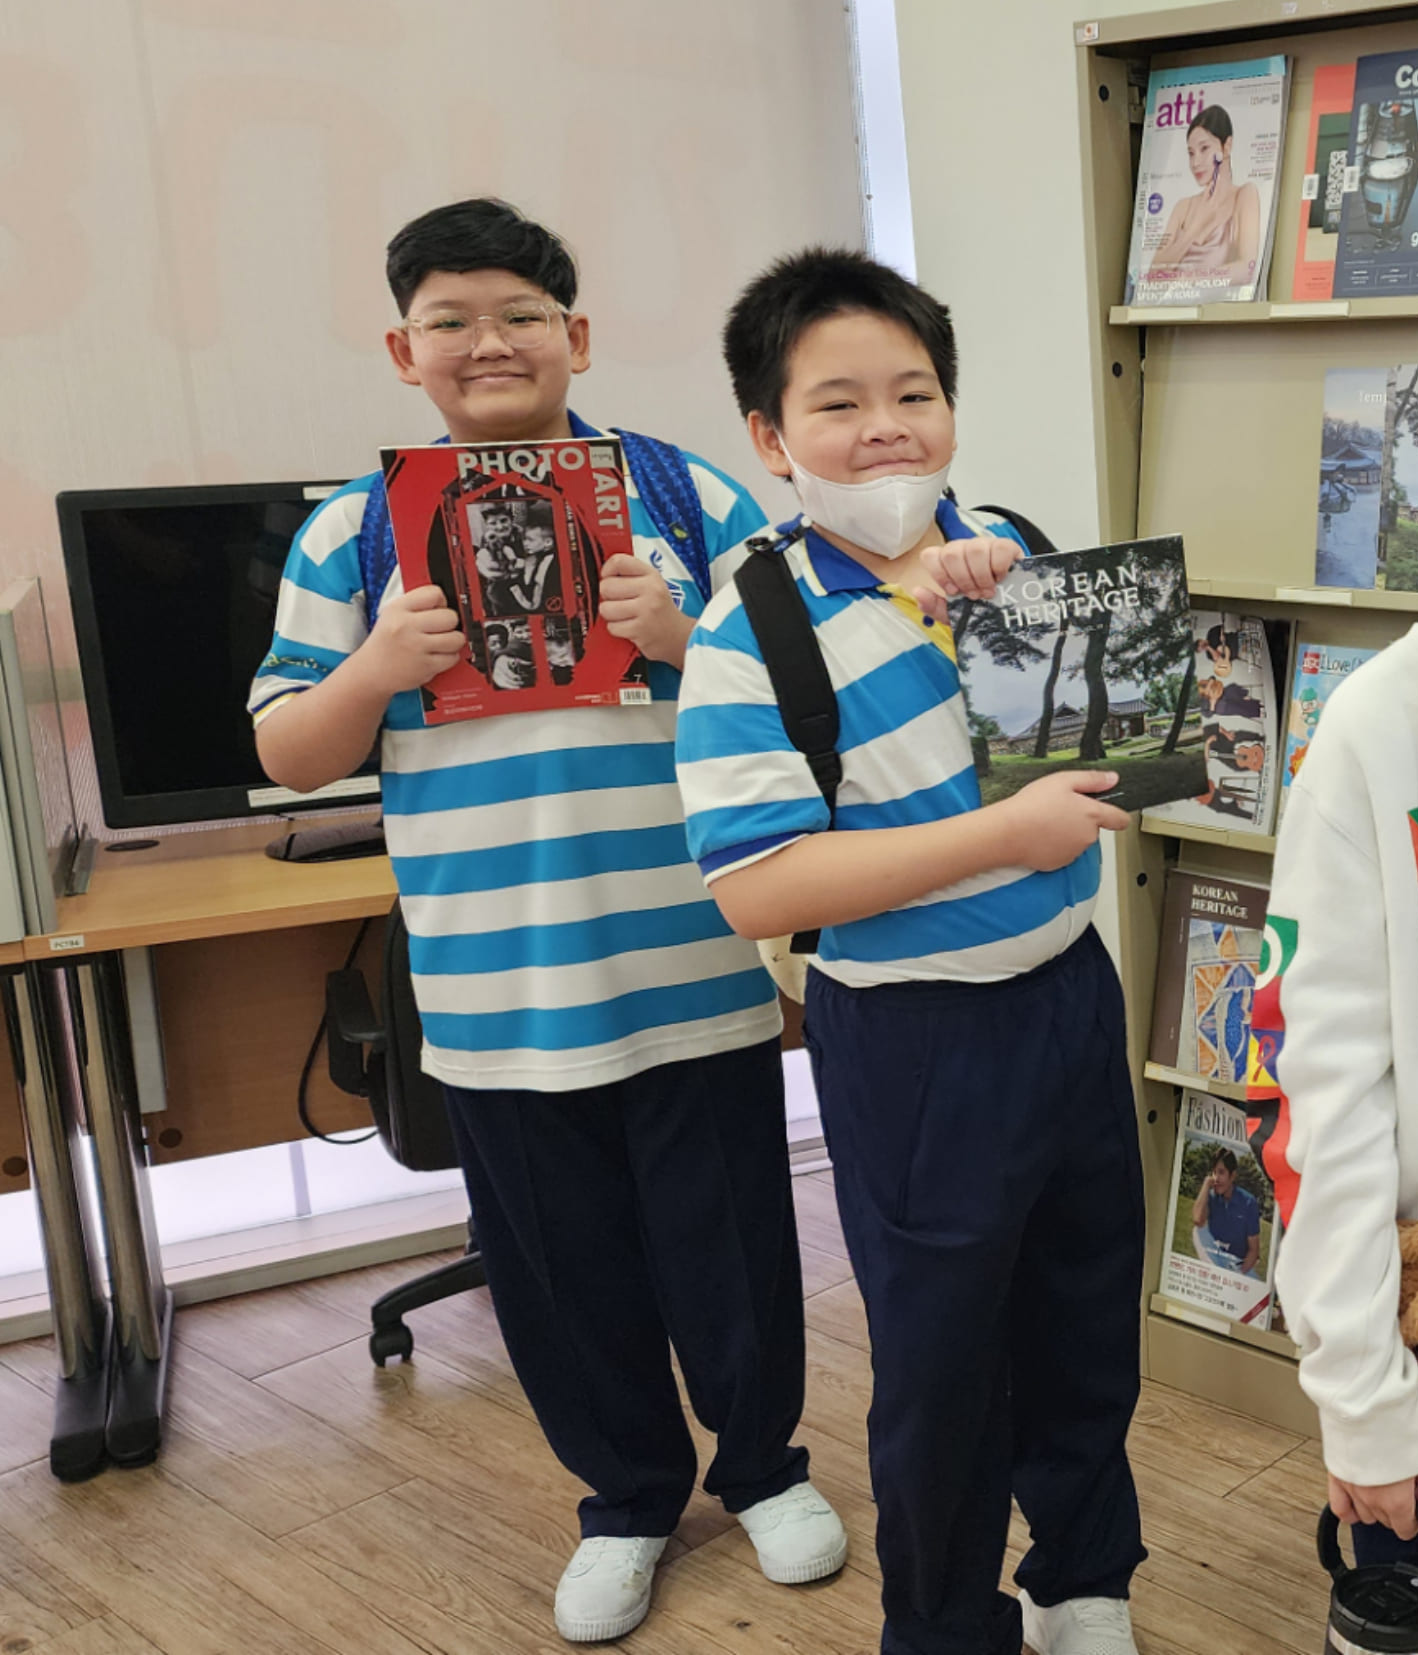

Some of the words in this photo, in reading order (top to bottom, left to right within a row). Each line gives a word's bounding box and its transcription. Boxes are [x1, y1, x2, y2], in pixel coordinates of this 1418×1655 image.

[456, 446, 586, 478] PHOTO
[591, 472, 624, 530] ART
[999, 564, 1139, 605] KOREAN
[1001, 586, 1140, 629] HERITAGE
[1191, 898, 1249, 920] HERITAGE
[1192, 883, 1239, 903] KOREAN
[1186, 1096, 1247, 1143] Fashion
